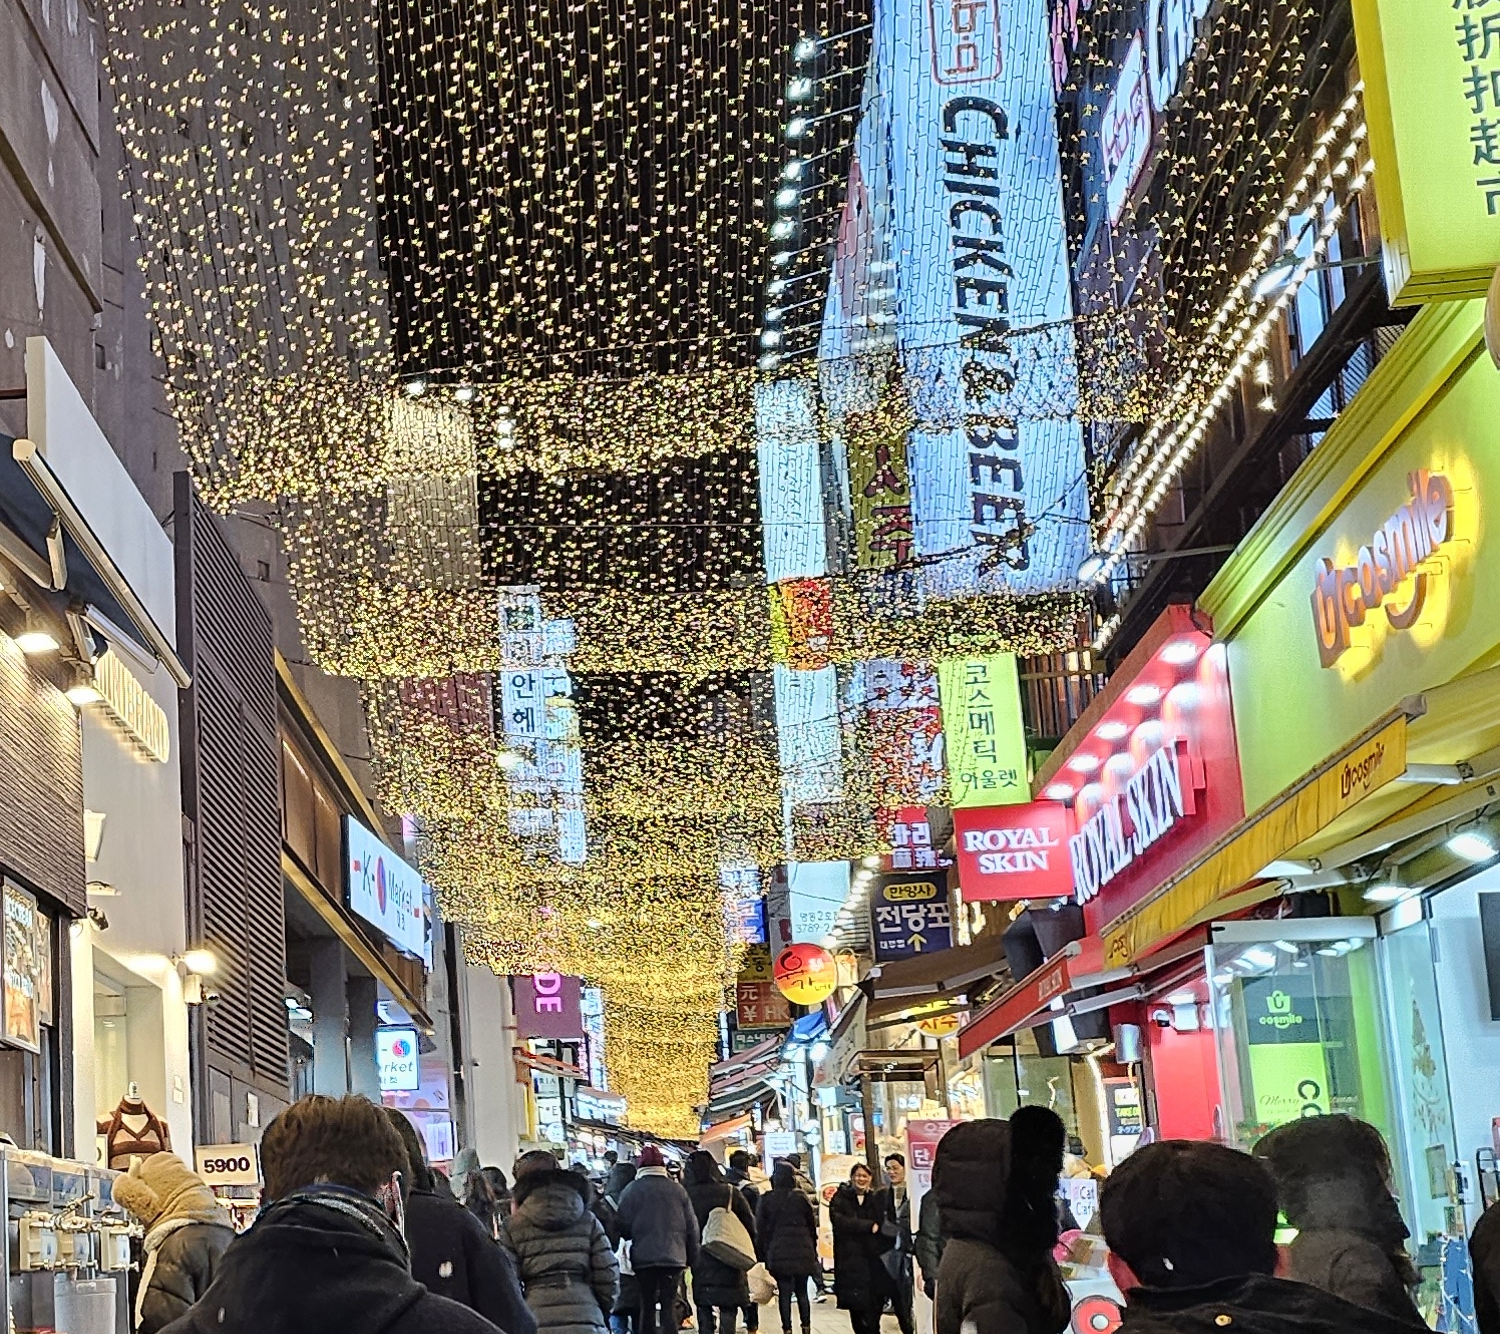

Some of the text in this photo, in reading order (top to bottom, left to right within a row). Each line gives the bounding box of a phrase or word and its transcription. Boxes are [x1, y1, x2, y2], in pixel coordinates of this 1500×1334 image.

[964, 663, 998, 764] 코스메틱
[960, 769, 1017, 790] 아울렛
[1069, 740, 1185, 906] ROYAL SKIN
[964, 826, 1059, 853] ROYAL
[978, 850, 1050, 875] SKIN
[384, 1061, 414, 1073] rket
[204, 1156, 250, 1175] 5900
